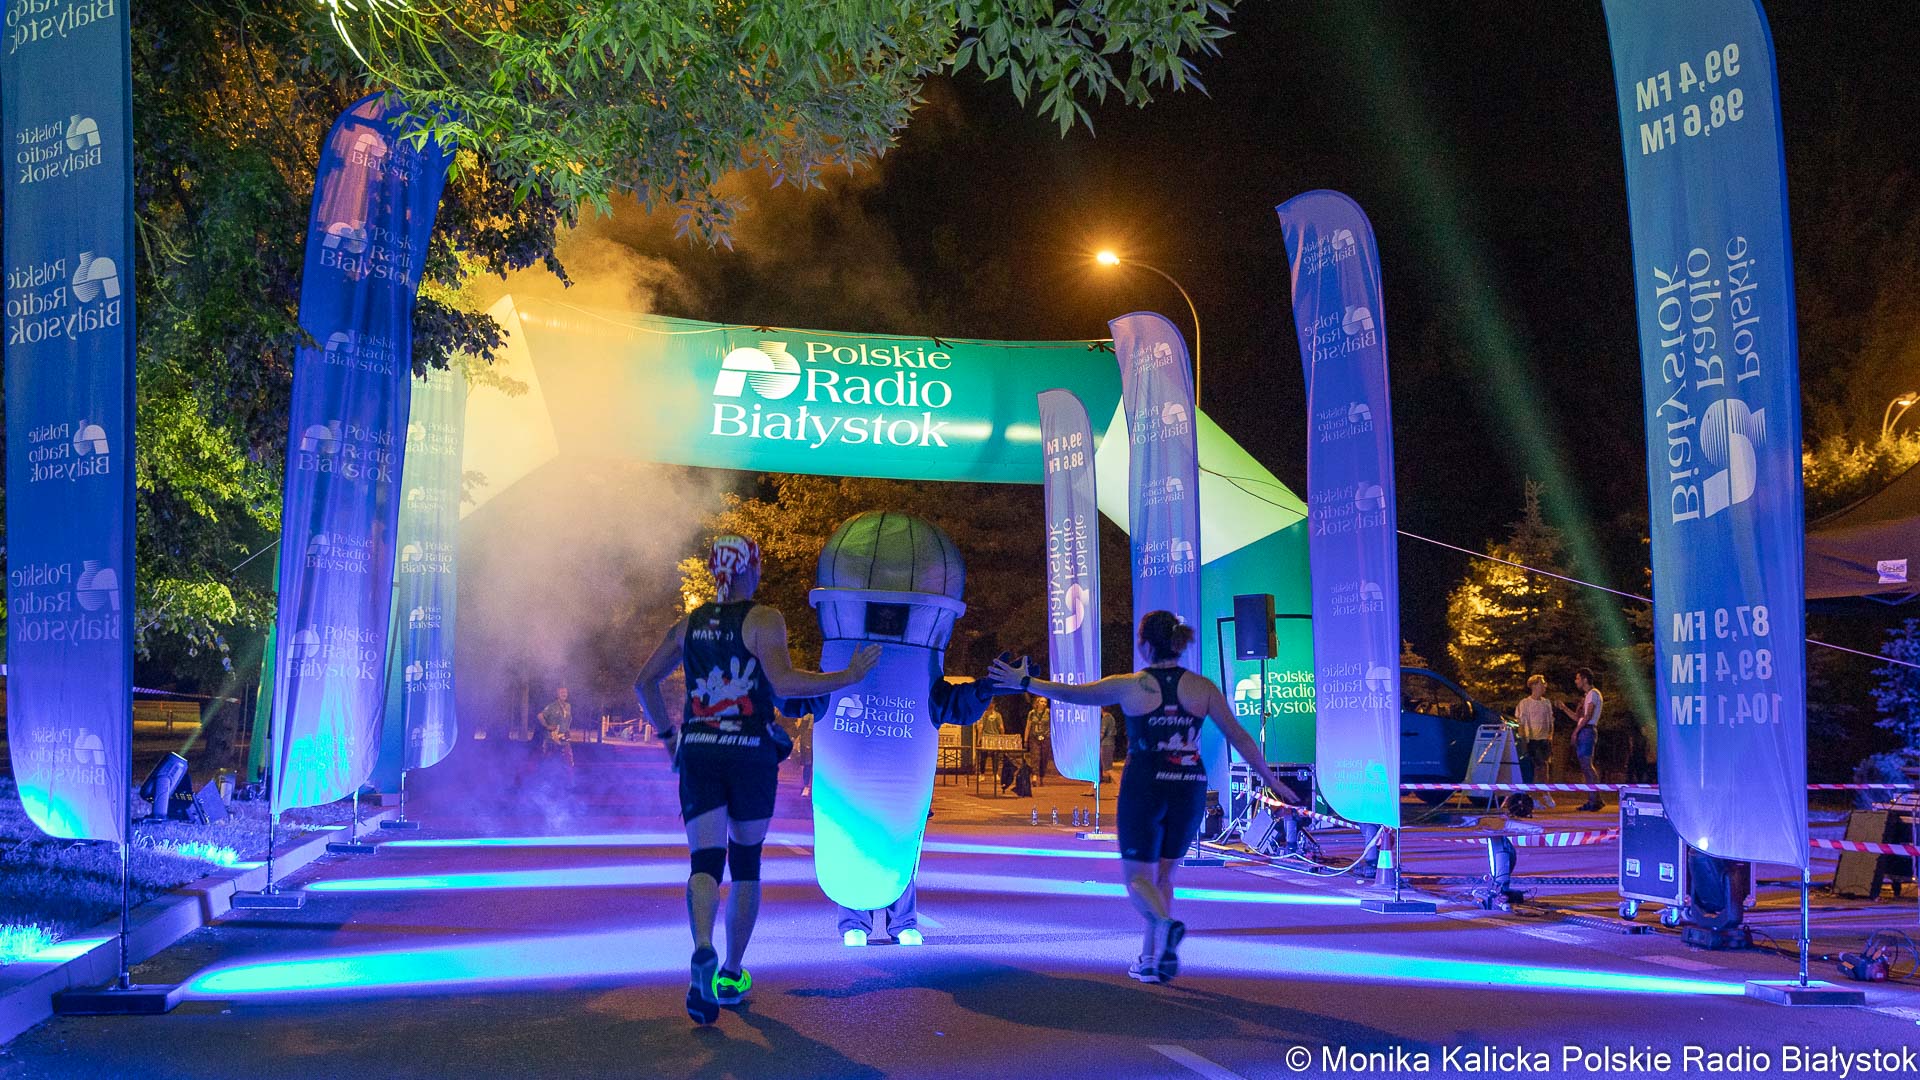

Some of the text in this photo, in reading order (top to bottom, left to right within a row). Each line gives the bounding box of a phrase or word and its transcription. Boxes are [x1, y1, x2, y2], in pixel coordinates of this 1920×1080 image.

[373, 226, 414, 253] Polsk
[805, 341, 952, 370] Polskie
[804, 368, 953, 408] Radio
[343, 424, 398, 447] Polskie
[710, 403, 949, 449] Białystok
[342, 442, 398, 466] Radio
[332, 532, 374, 548] Polskie
[331, 545, 371, 561] Radio
[325, 624, 380, 645] Polskie
[1268, 670, 1314, 683] Polskie
[1268, 683, 1316, 699] Radio
[866, 694, 916, 710] Polskie
[864, 706, 915, 724] Radio
[833, 717, 913, 739] Białystok
